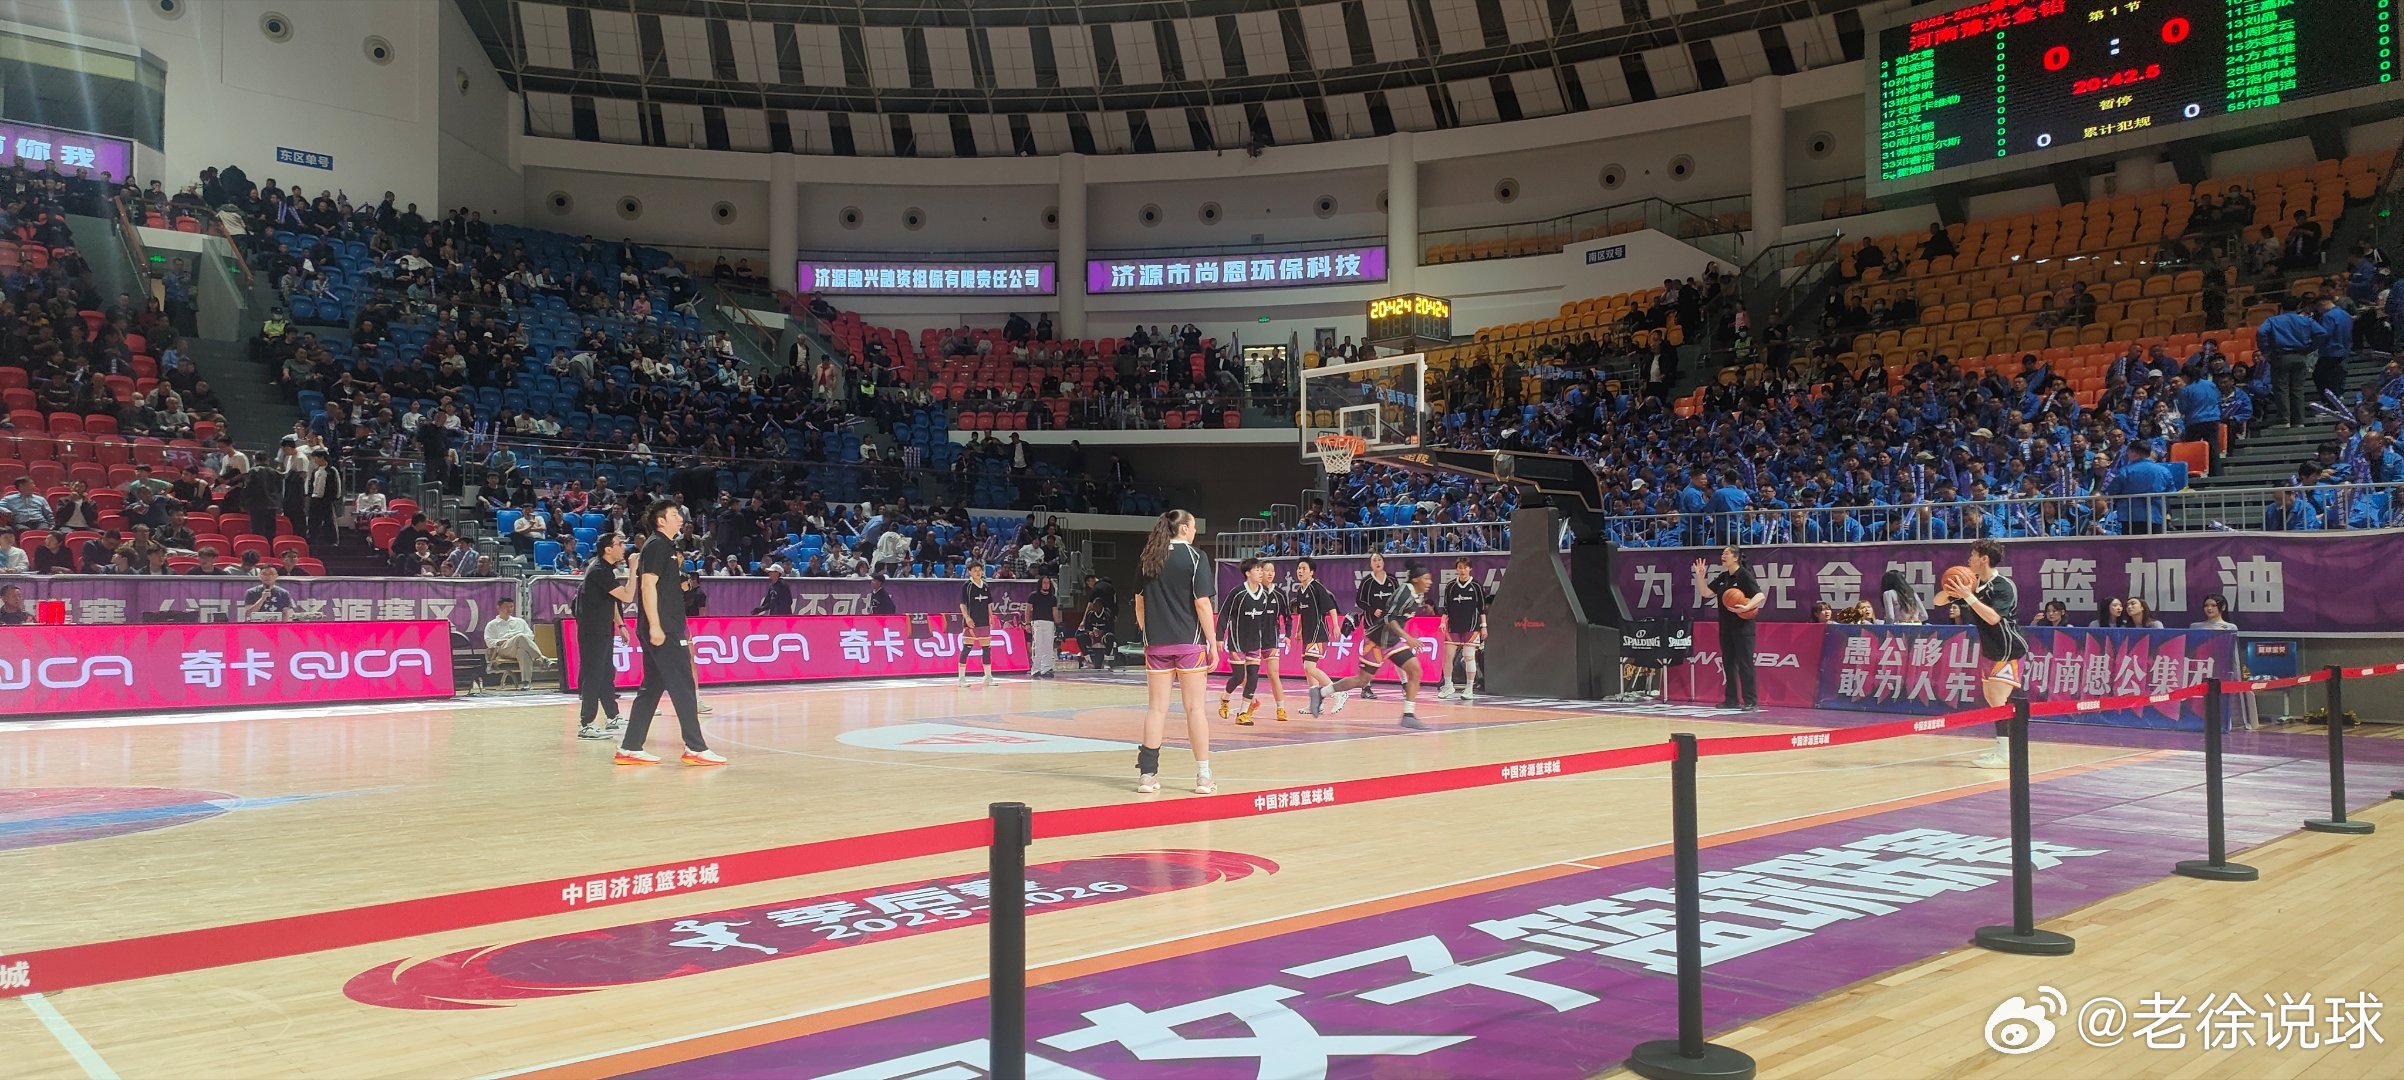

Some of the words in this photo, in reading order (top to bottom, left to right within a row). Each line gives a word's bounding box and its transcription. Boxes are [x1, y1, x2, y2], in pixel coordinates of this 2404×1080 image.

[2043, 46, 2070, 71] 0
[2161, 17, 2190, 43] 0
[2184, 104, 2200, 118] 0
[0, 135, 96, 169] 你我
[2037, 133, 2051, 147] 0
[280, 149, 330, 168] 东区单号
[815, 268, 1040, 288] 济源融兴融资担保有限责任公司
[1111, 253, 1361, 287] 济源市尚恩环保科技
[1634, 555, 2285, 615] 为光金铅篮加油
[839, 628, 904, 664] 奇卡
[1623, 636, 1661, 648] SPALDING
[1843, 636, 1981, 669] 愚公移山
[180, 648, 274, 687] 奇卡
[2023, 651, 2215, 700] 河南愚公集团
[1838, 669, 1976, 703] 敢为人先
[1501, 760, 1561, 780] 中国济源篮球城
[1254, 787, 1334, 812] 中国济源篮球城
[561, 862, 720, 906] 中国济源篮球城
[811, 880, 1128, 941] 2025-026
